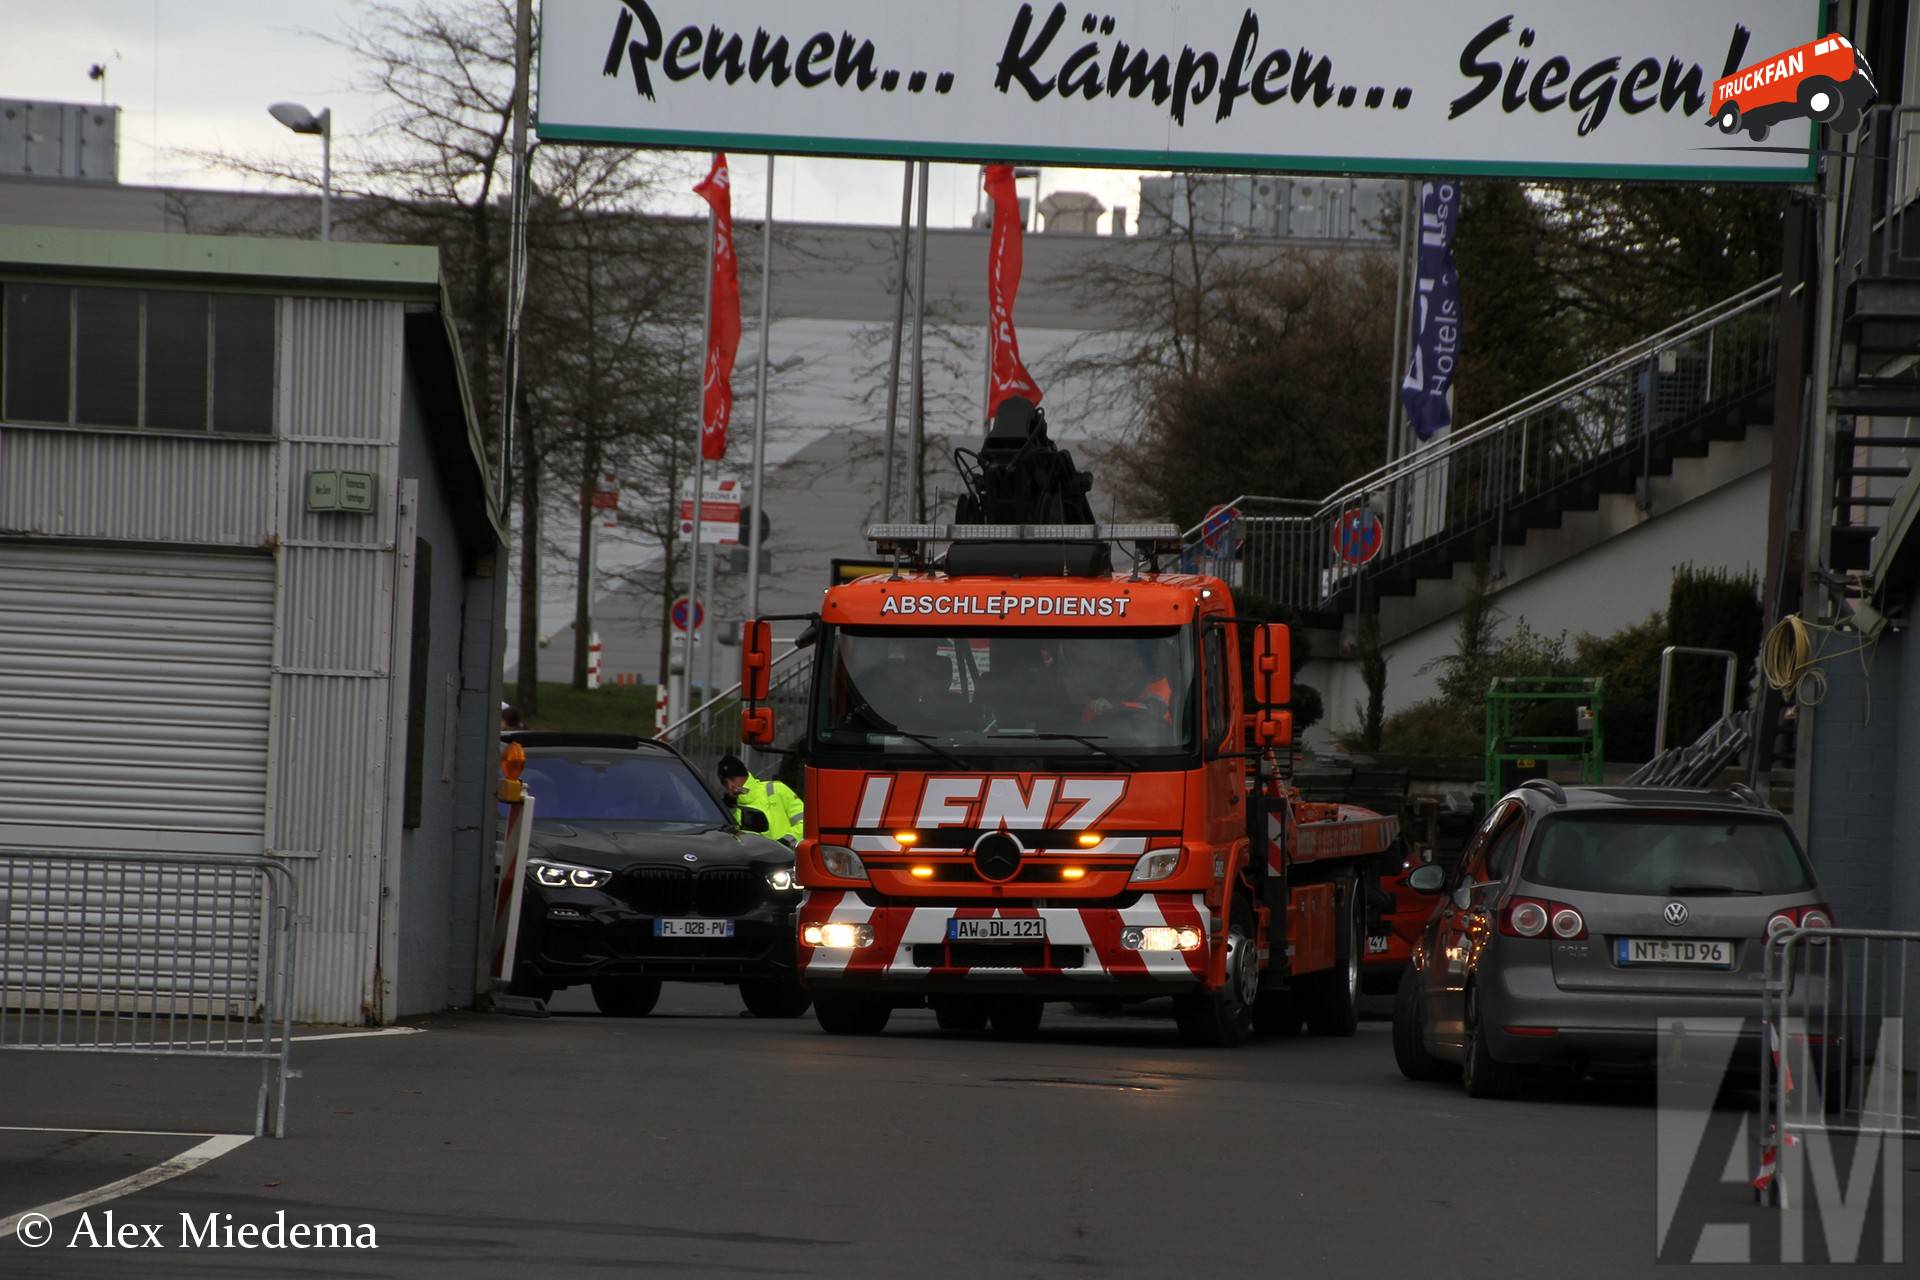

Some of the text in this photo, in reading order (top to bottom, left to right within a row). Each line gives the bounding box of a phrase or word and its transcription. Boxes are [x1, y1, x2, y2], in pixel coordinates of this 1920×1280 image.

[603, 0, 955, 102] Rennen...
[995, 2, 1412, 127] Kämpfen...
[882, 595, 1130, 616] ABSCHLEPPDIENST
[959, 921, 1043, 937] AW DL 121
[1635, 942, 1722, 961] NT TD 96
